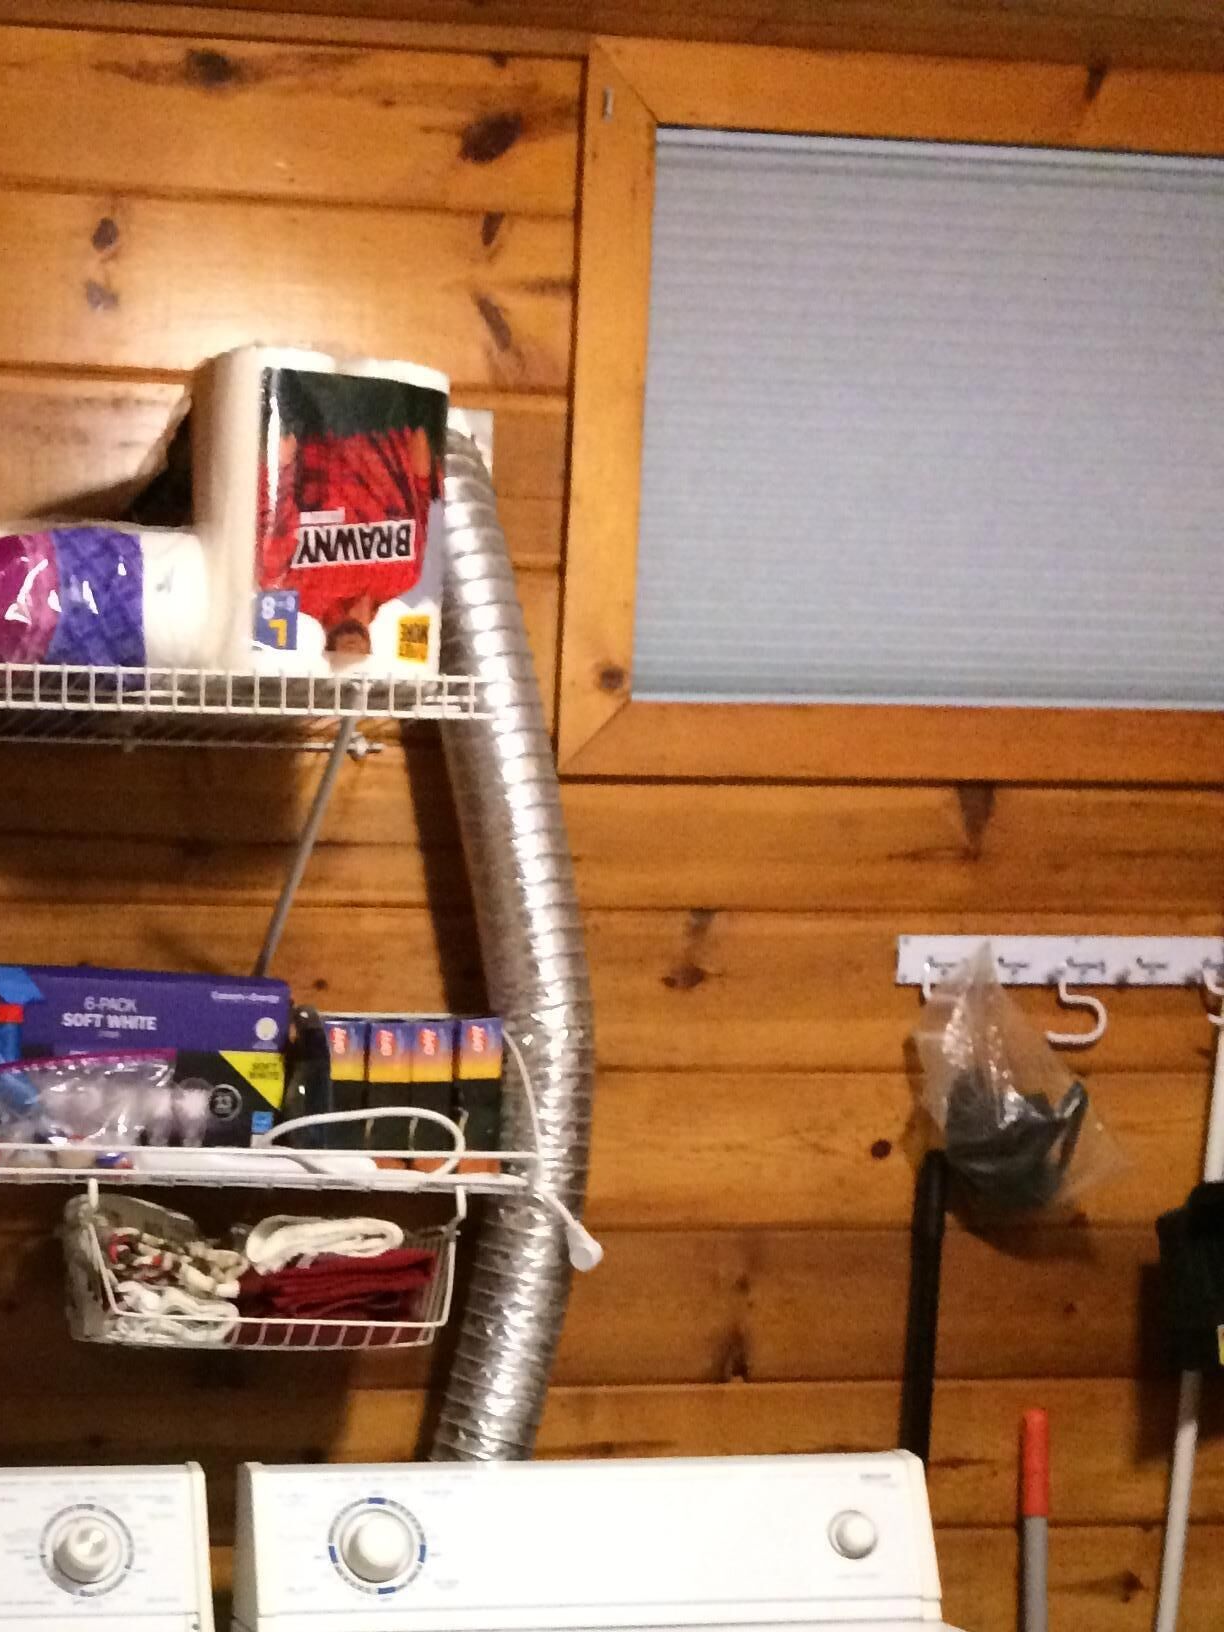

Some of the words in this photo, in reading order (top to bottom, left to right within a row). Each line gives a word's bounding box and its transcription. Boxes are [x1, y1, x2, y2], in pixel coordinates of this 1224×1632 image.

[297, 524, 411, 564] BRAWNY
[83, 995, 137, 1013] 6-PACK
[61, 1012, 103, 1028] SOFT
[107, 1014, 158, 1031] WHITE
